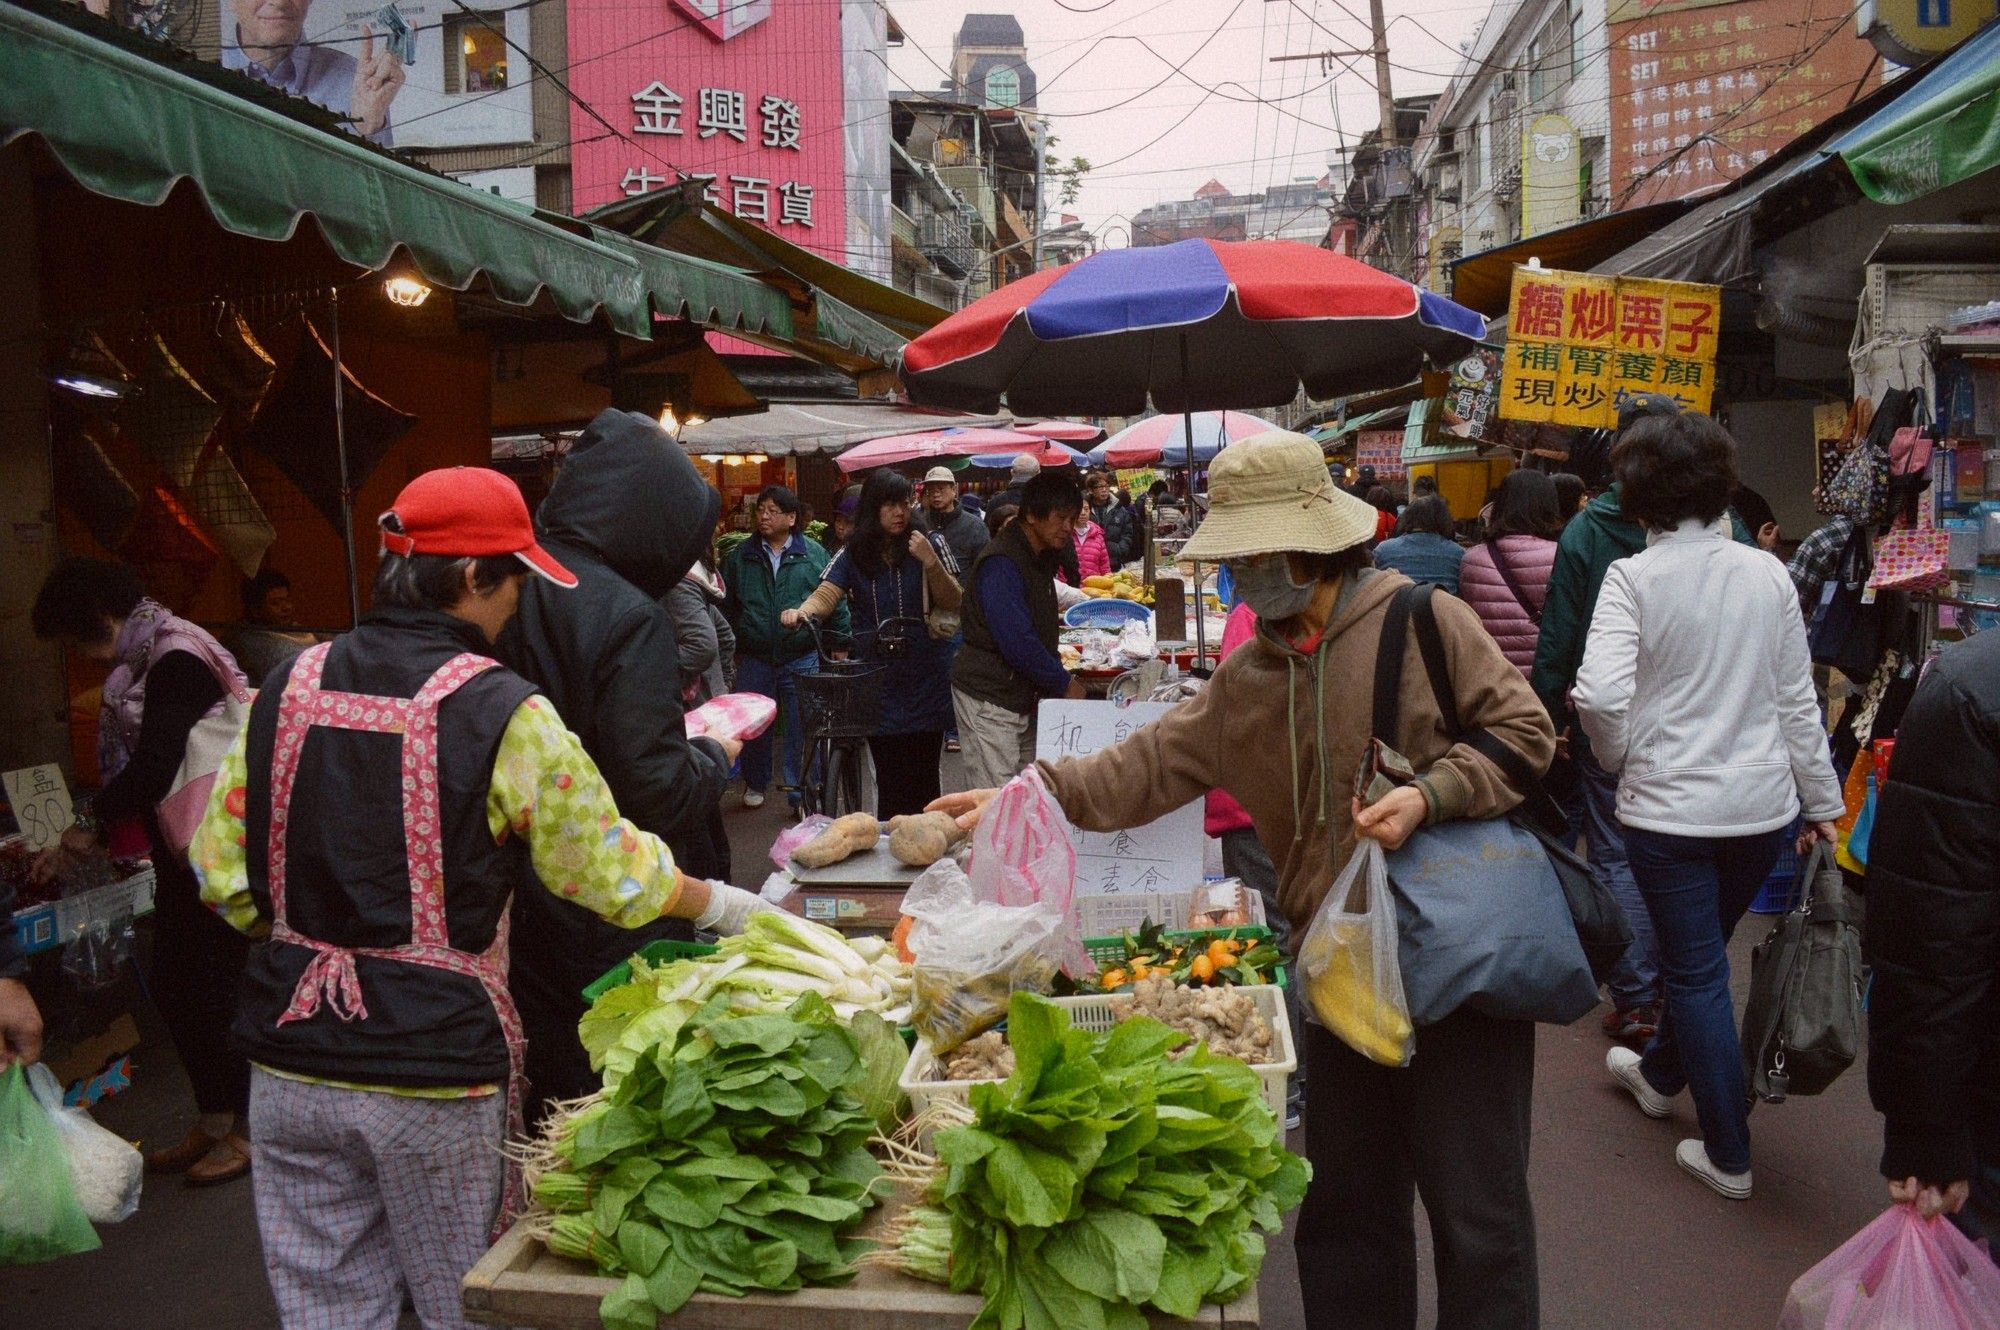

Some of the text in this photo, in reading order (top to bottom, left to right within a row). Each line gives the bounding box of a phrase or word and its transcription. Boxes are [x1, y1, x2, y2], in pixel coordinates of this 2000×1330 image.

[1628, 31, 1657, 51] SET
[1631, 60, 1659, 81] SET
[632, 80, 800, 150] 金興發
[1515, 281, 1713, 353] 糖炒栗子
[1517, 342, 1703, 388] 補腎養顏
[1456, 389, 1474, 419] 元氣
[1469, 394, 1491, 439] 好咖啡
[22, 798, 66, 846] 80
